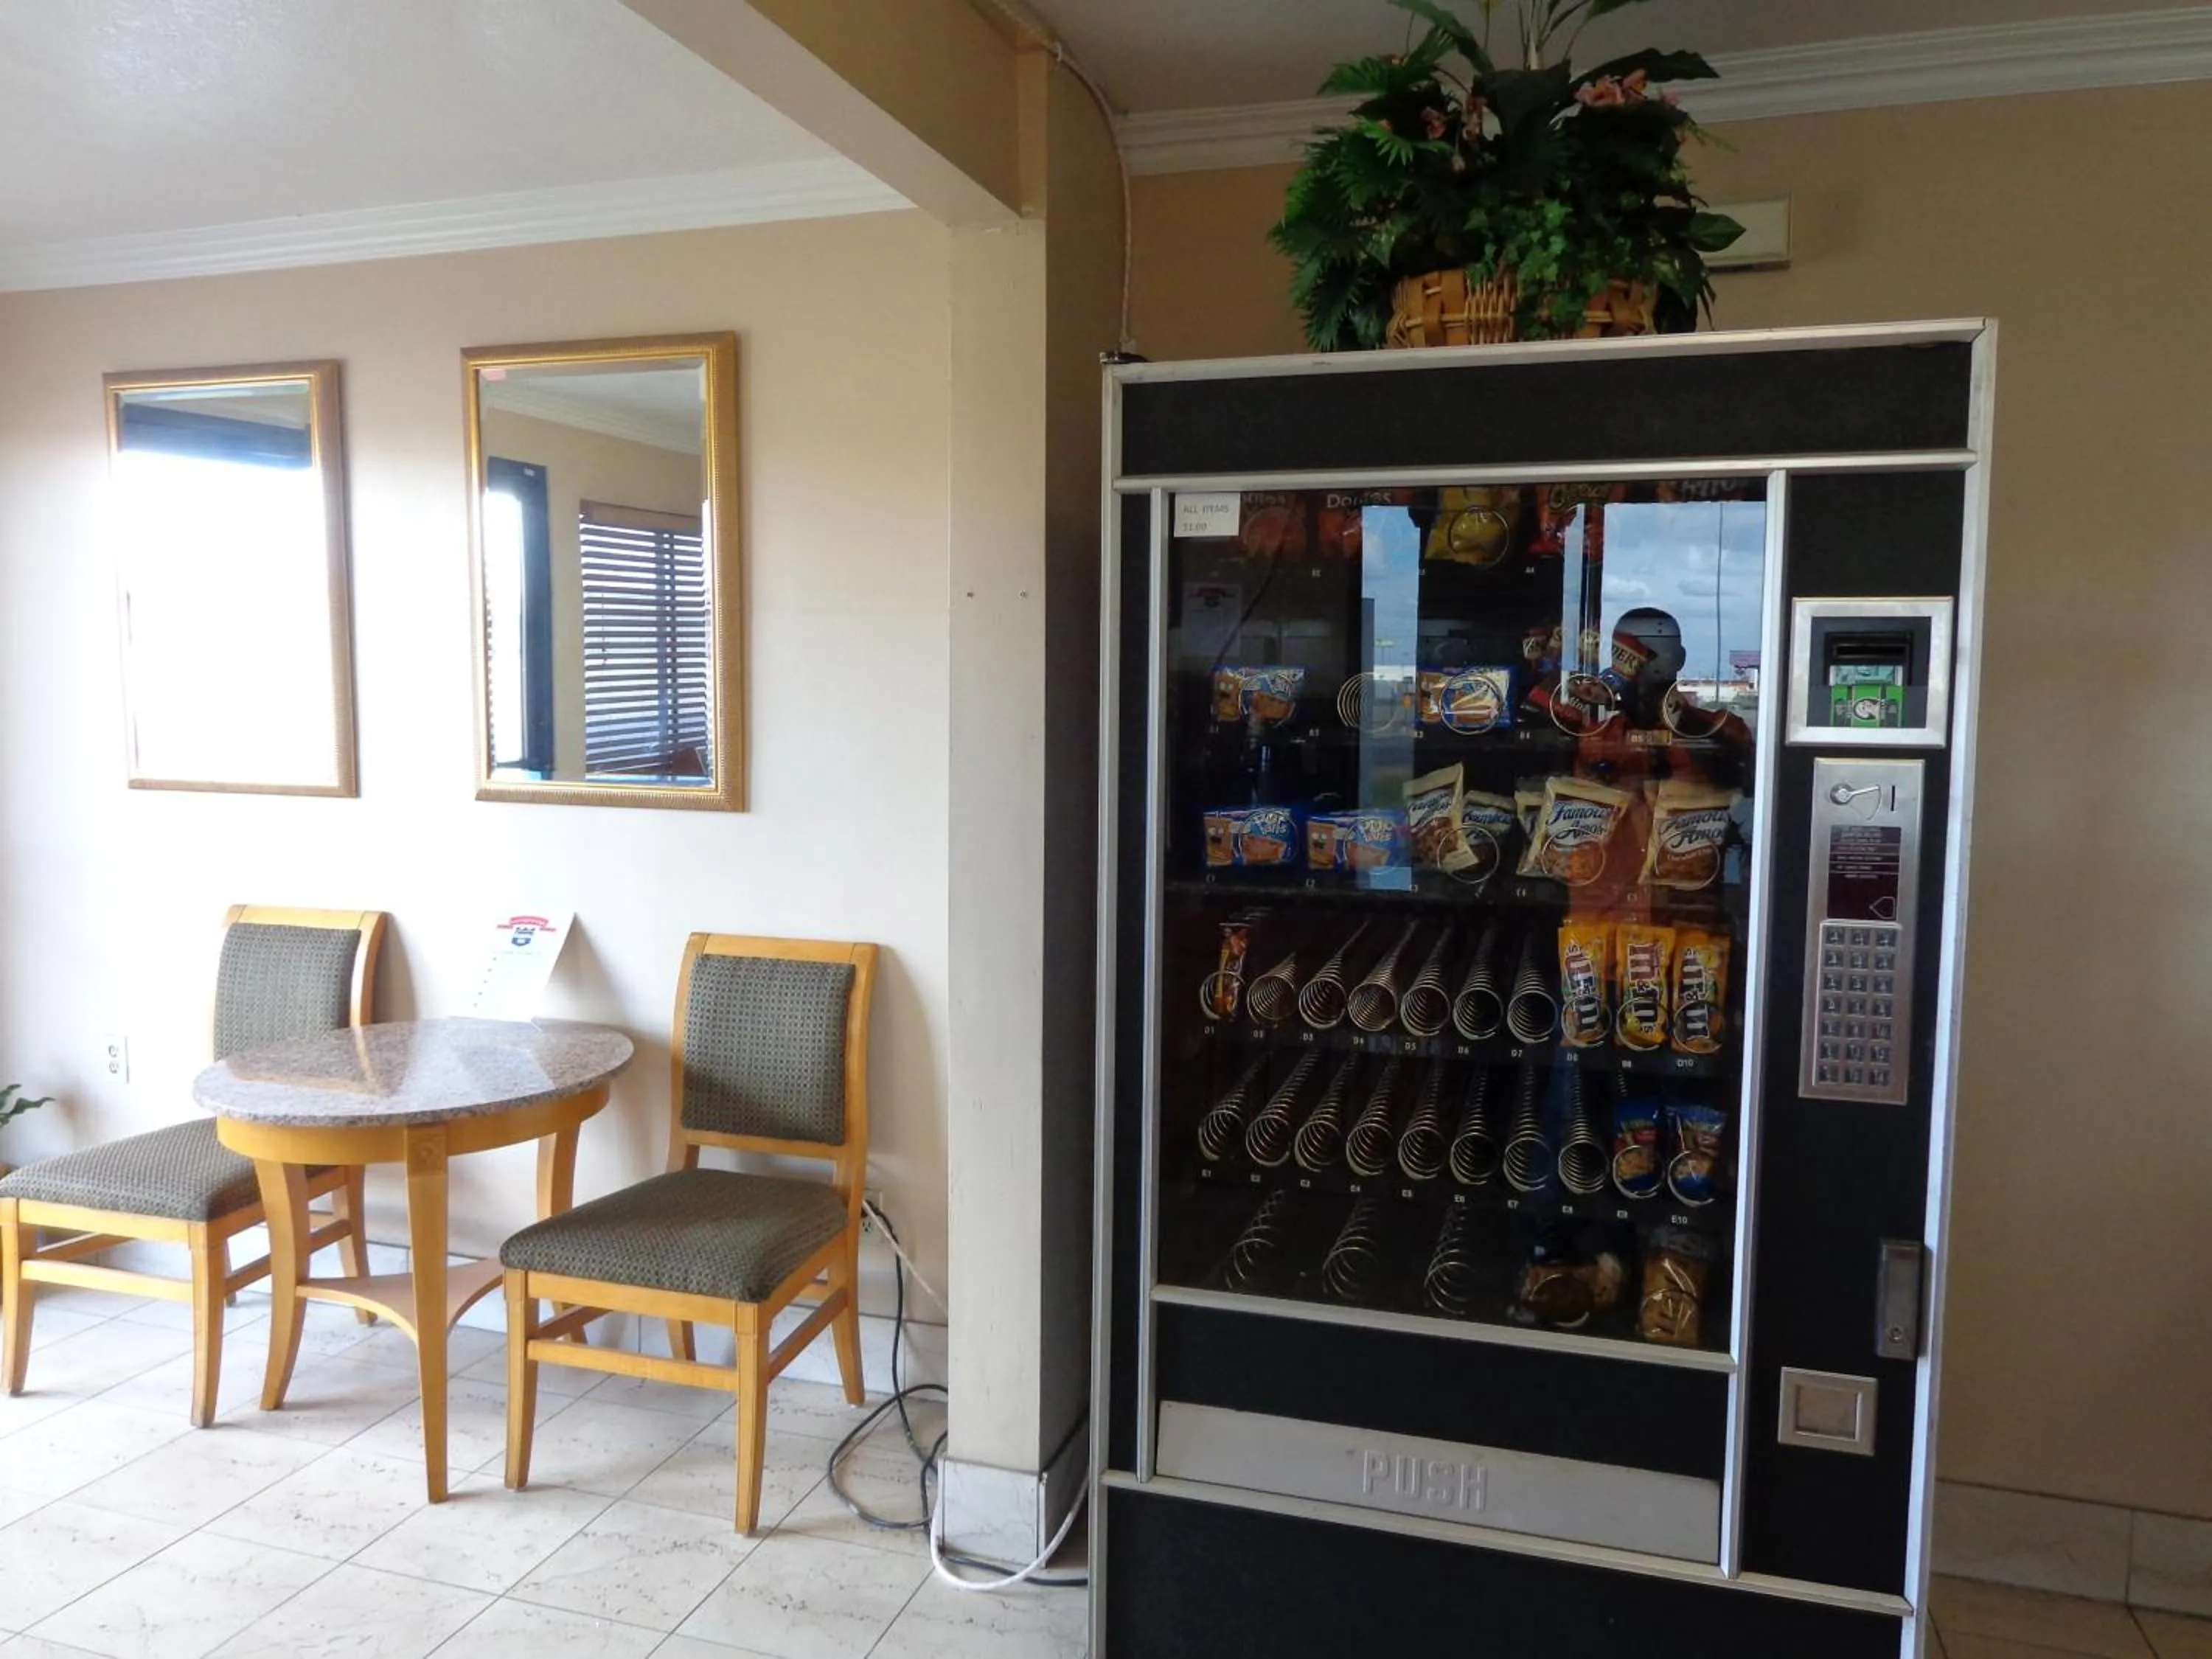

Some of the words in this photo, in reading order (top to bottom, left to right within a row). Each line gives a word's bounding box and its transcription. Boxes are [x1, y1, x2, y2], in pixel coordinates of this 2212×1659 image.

[1183, 504, 1197, 514] ALL
[1512, 1049, 1523, 1059] D7
[1677, 1059, 1694, 1068] D10
[1671, 1214, 1688, 1224] E10
[1363, 1449, 1488, 1511] PUSH
